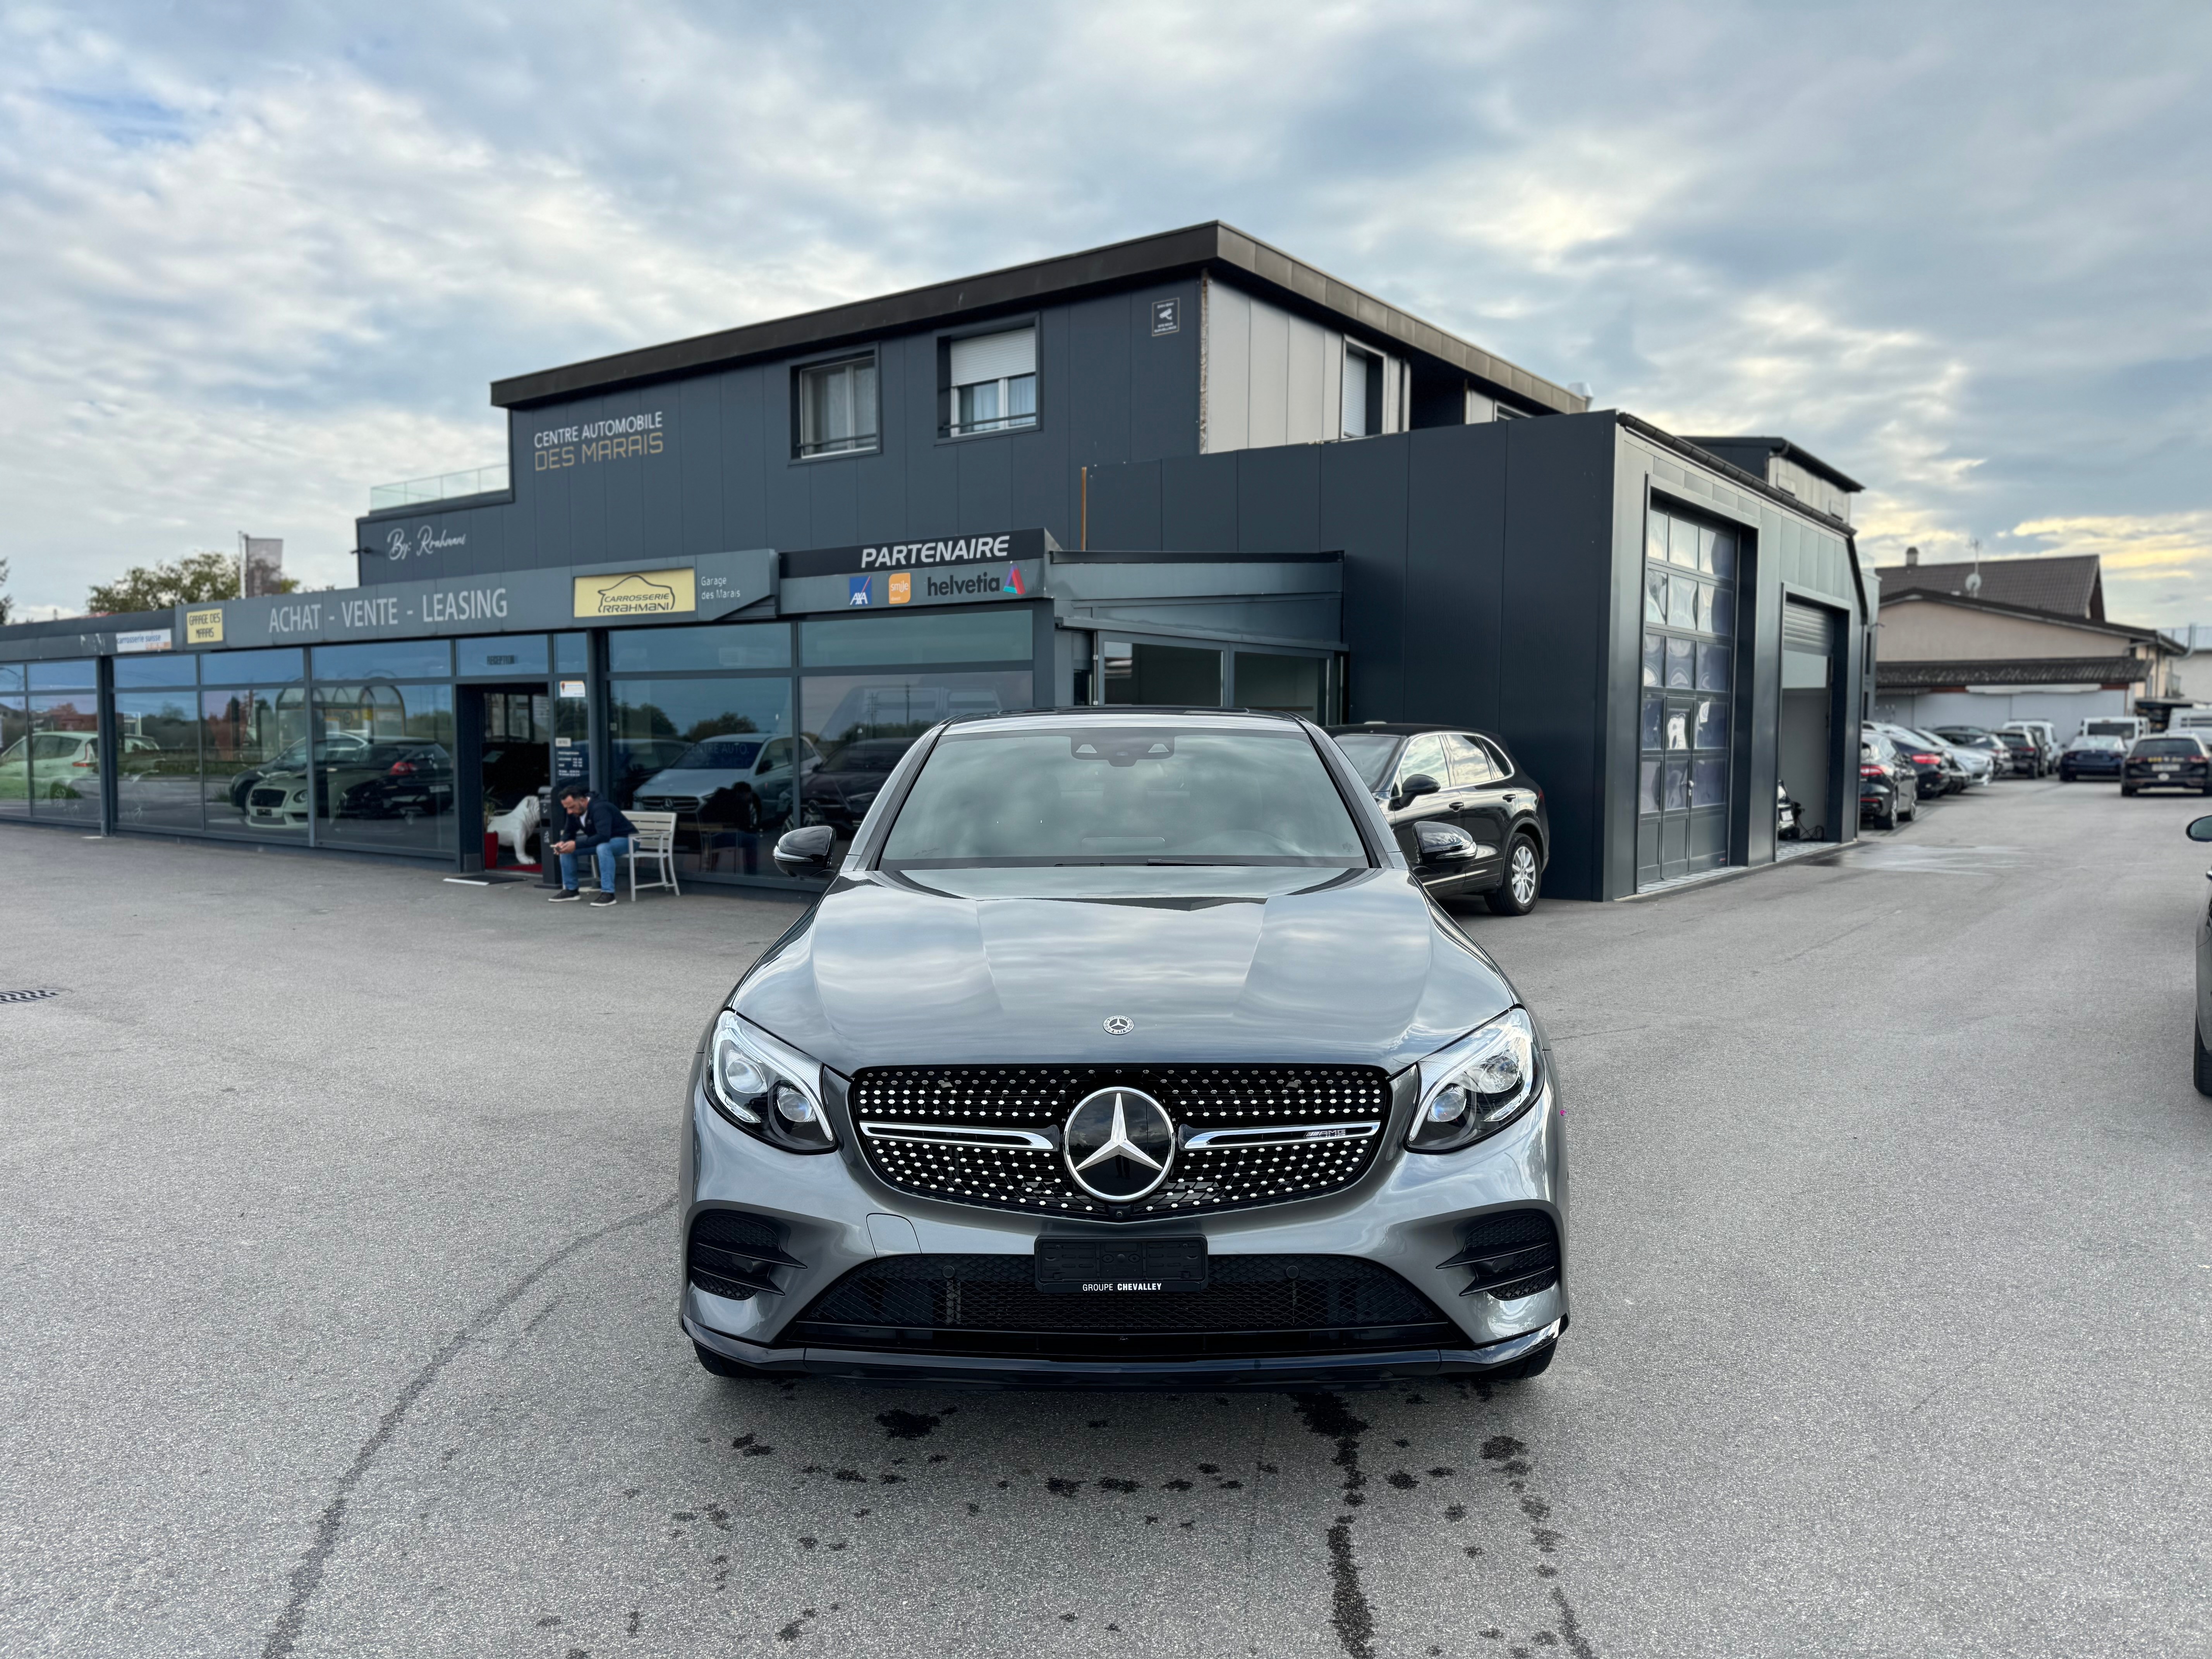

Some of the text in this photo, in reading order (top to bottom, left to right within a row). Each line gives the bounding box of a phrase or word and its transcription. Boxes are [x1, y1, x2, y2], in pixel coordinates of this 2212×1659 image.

[534, 411, 663, 448] CENTRE AUTOMOBILE
[535, 432, 663, 471] DES MARAIS
[861, 536, 1010, 568] PARTENAIRE
[701, 576, 727, 587] Garage
[890, 580, 909, 593] smile
[927, 572, 1000, 597] helvetia
[605, 593, 670, 603] CARROSSERIE
[701, 589, 741, 599] des Marais
[850, 592, 868, 605] AXA
[269, 604, 321, 633] ACHAT
[342, 598, 398, 628] VENTE
[422, 588, 507, 622] LEASING
[189, 613, 220, 625] GARAGE DES
[117, 634, 144, 644] carrosserie
[196, 628, 214, 639] MARAIS
[1082, 1283, 1162, 1291] GROUPE CHEVALLEY
